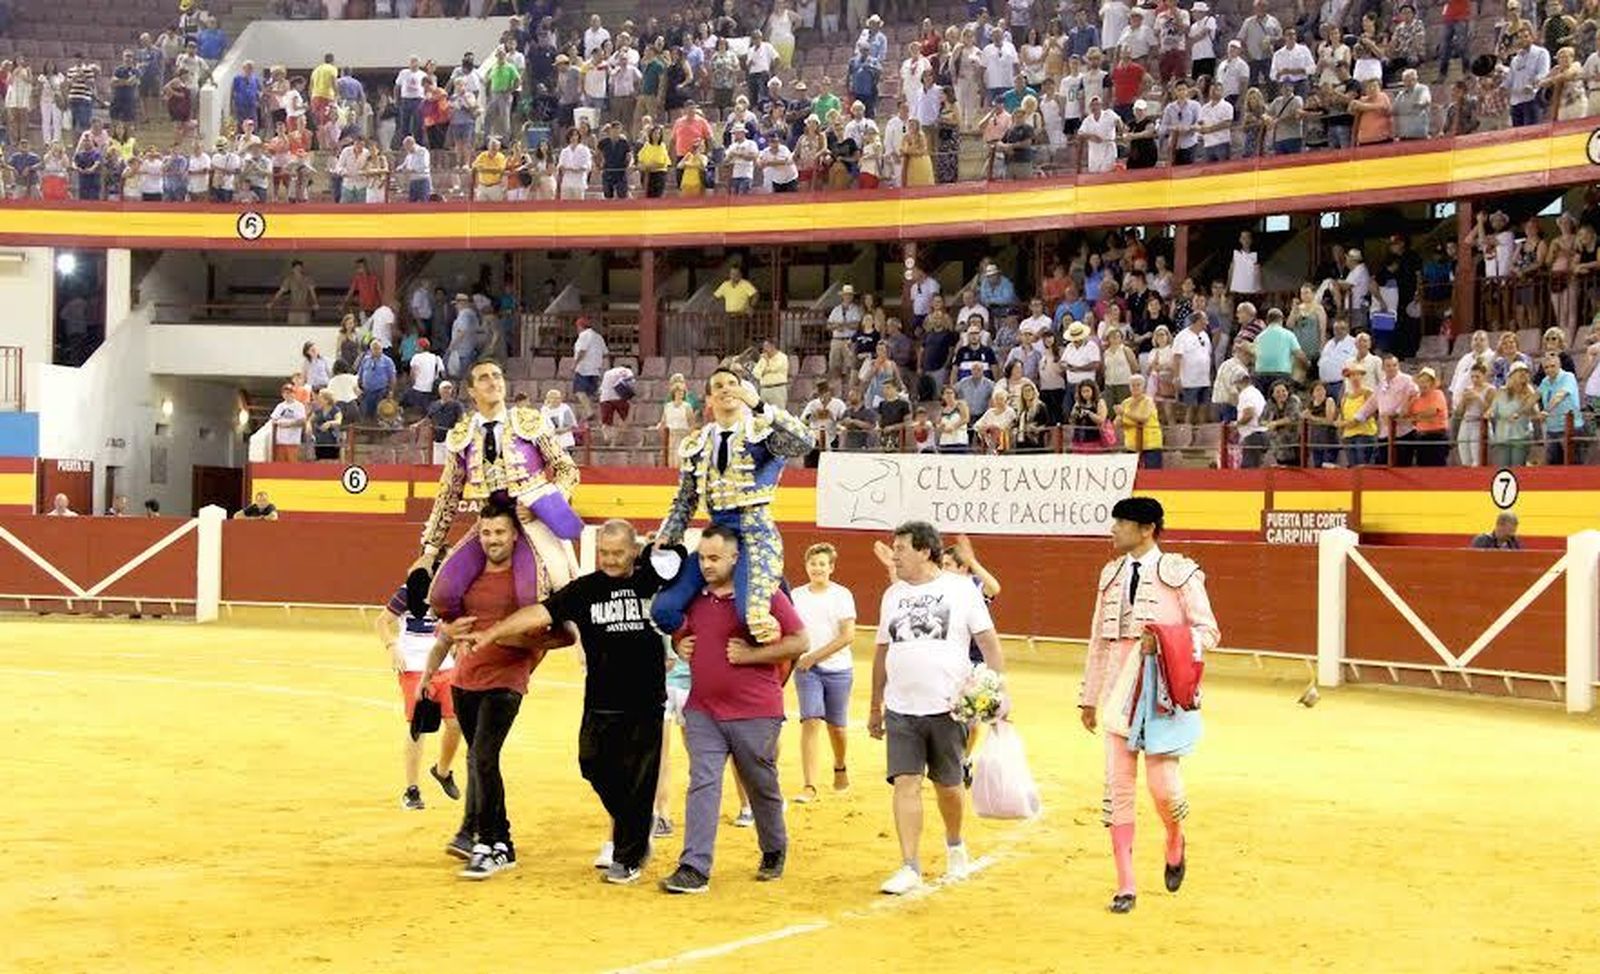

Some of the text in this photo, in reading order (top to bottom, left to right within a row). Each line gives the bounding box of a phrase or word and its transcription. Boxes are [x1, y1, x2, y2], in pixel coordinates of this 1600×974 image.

[245, 216, 257, 235] 6
[349, 470, 360, 488] 6
[916, 465, 1128, 492] CLUB TAURINO
[1499, 478, 1511, 503] 7
[931, 500, 1109, 525] TORRE PACHECO
[1266, 512, 1348, 528] PUERTA DE CORTE
[1266, 528, 1321, 544] CARPINT
[590, 598, 625, 624] PALACIO
[625, 598, 641, 621] DEL
